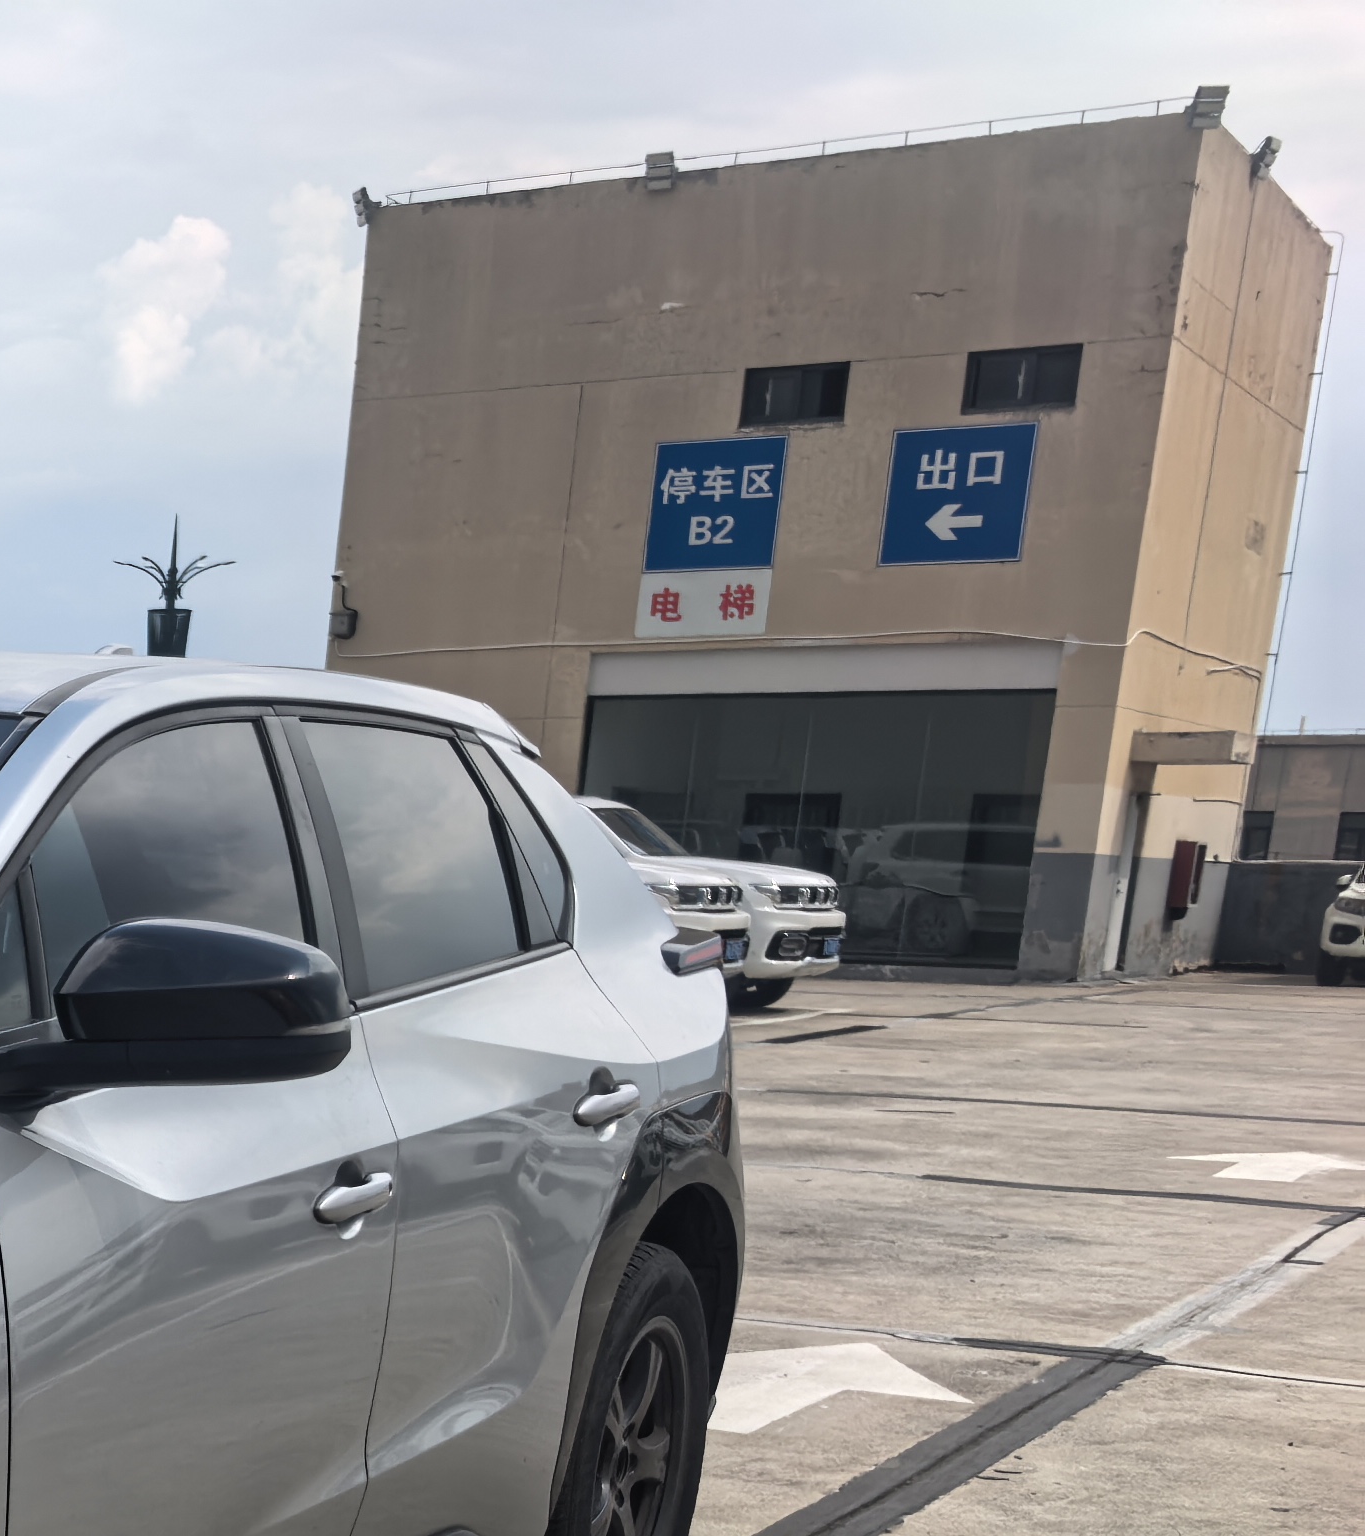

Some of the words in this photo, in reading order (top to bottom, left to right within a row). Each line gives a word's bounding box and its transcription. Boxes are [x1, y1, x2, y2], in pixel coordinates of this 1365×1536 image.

[660, 464, 775, 504] 停车区
[916, 449, 1004, 490] 出口
[688, 515, 735, 545] B2
[650, 584, 755, 622] 电梯
